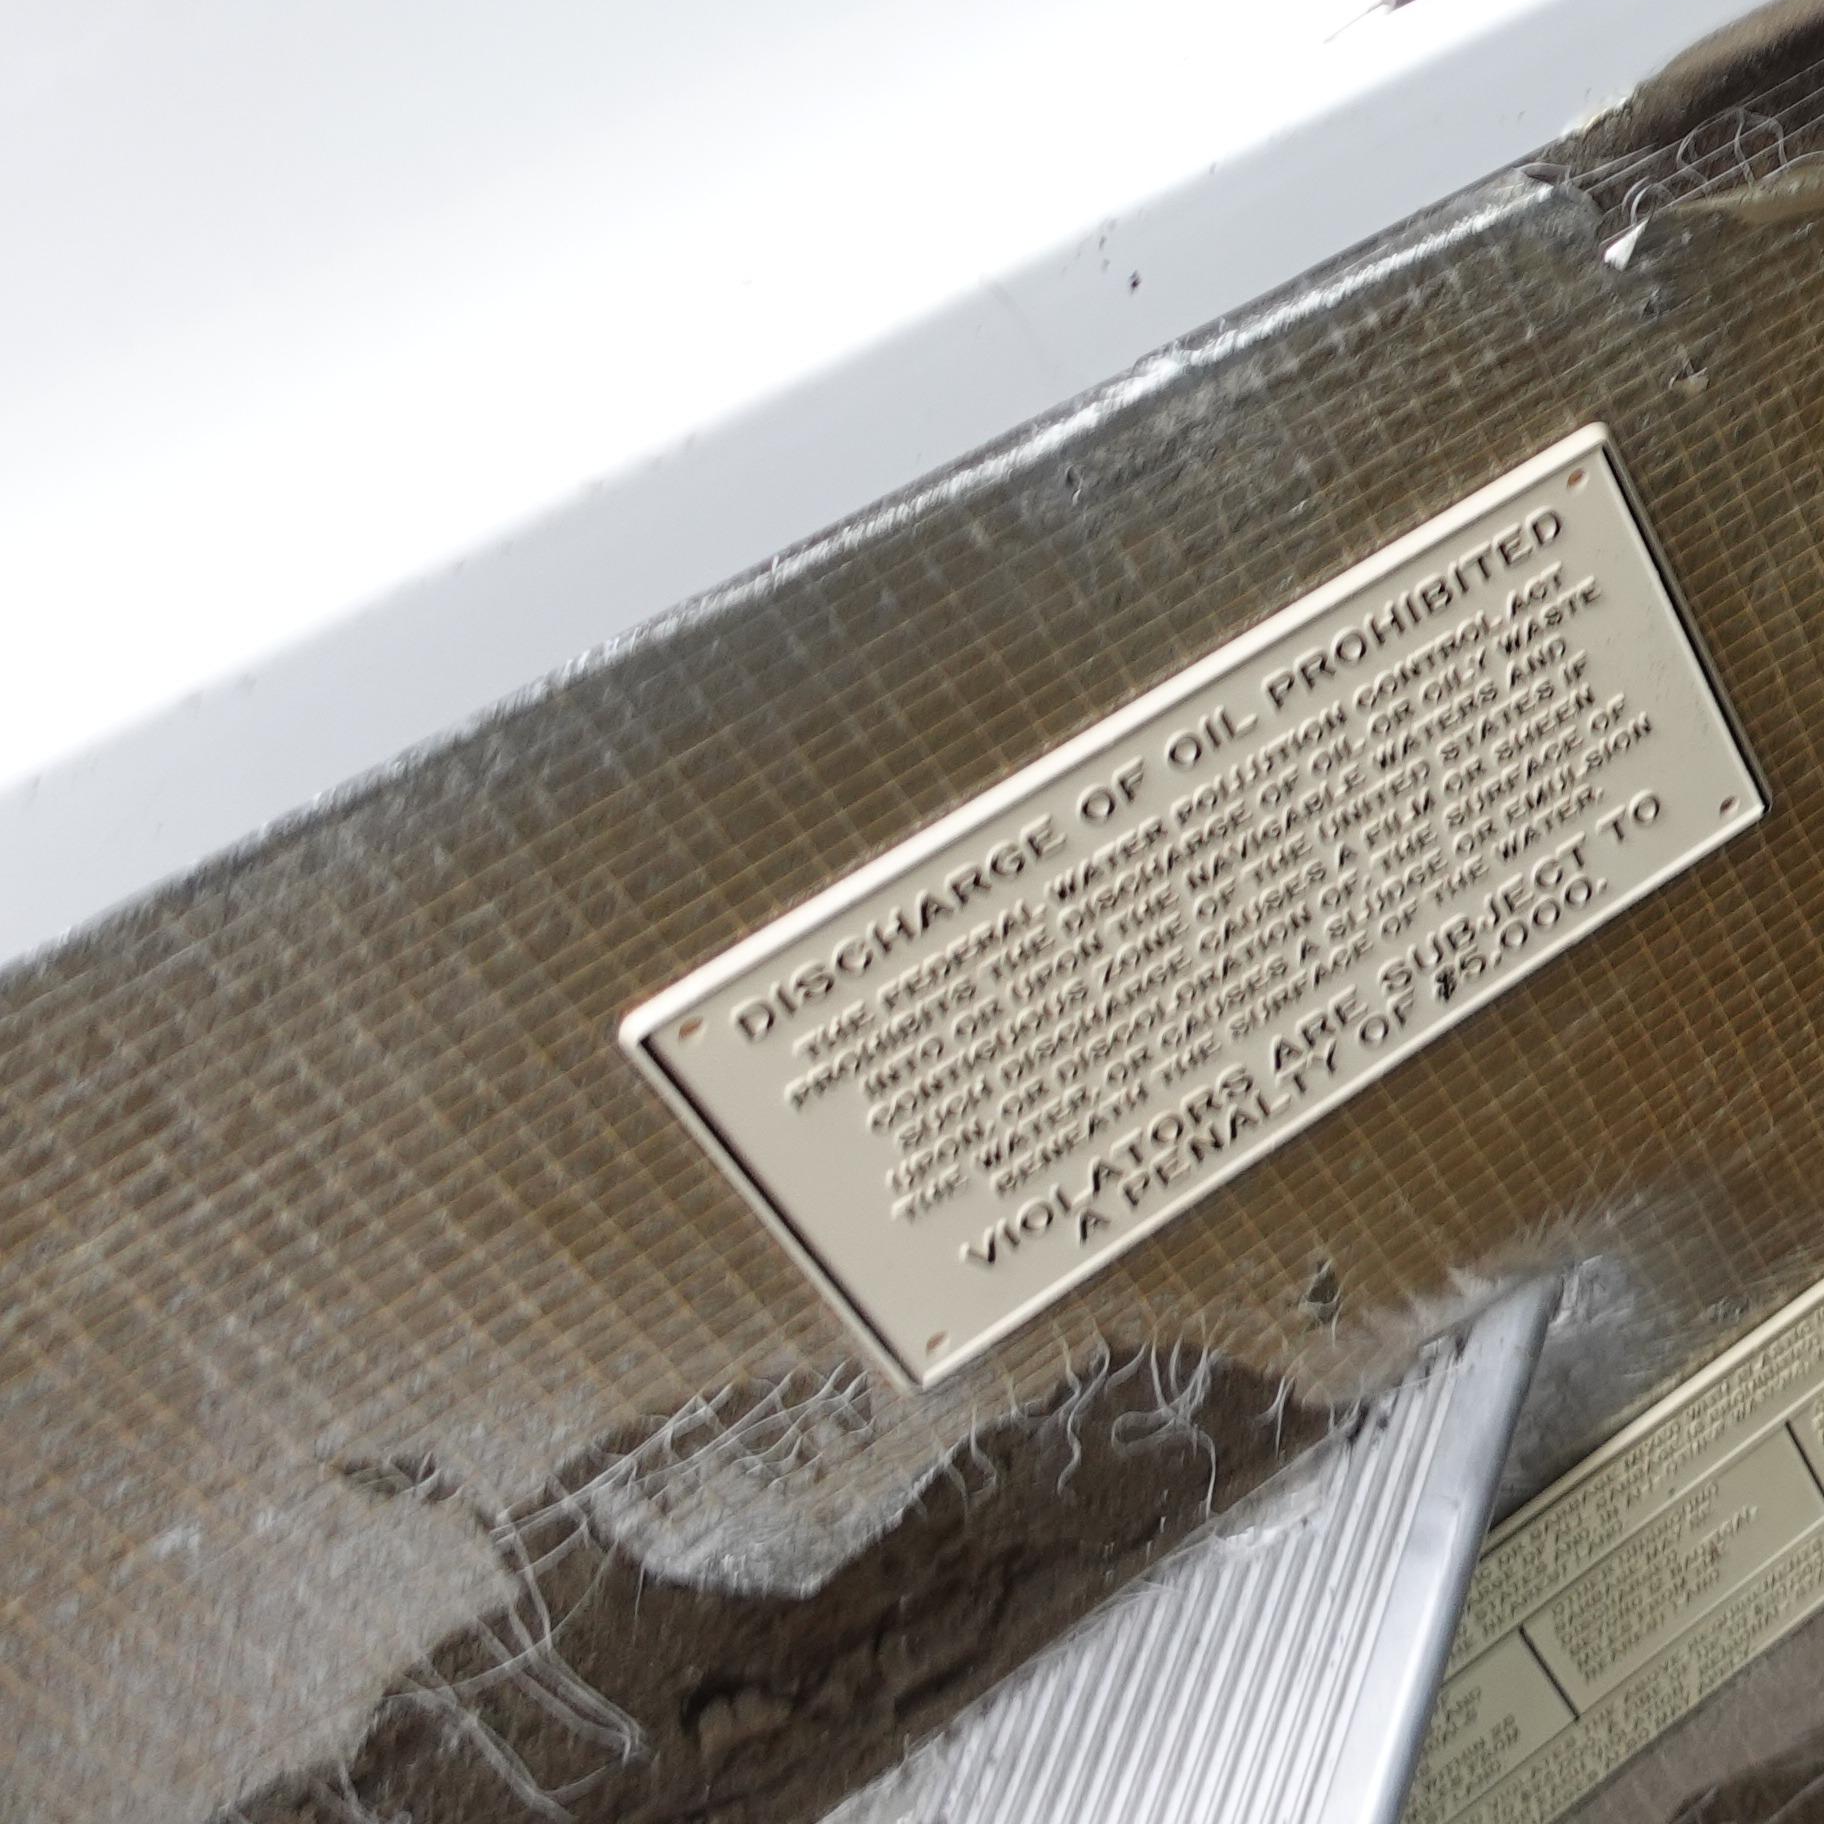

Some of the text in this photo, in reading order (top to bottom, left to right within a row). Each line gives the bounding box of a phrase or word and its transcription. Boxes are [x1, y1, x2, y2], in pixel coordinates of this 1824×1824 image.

[722, 498, 1567, 1045] DISCHARGE OF OIL PROHIBITED
[778, 575, 1603, 1111] PROHIBITS THE DISCHARGE OF OIL OR OILY WASTE
[786, 560, 1571, 1068] THE FEDERAL WATER POLLUTION CONTROL ACT
[851, 630, 1570, 1102] INTO OR UPON THE NAVIGABLE WATERS AND
[858, 649, 1595, 1136] CONTIGUOUS ZONE OF THE UNITED STATES IF
[884, 1161, 971, 1228] THE
[1097, 1040, 1155, 1089] OR
[1151, 950, 1292, 1054] CAUSES
[1288, 930, 1322, 965] A
[1320, 846, 1450, 944] SLUDGE
[1448, 813, 1499, 861] OR
[1499, 711, 1655, 827] EMULSION
[888, 682, 1597, 1153] SUCH DISCHARGE CAUSES A FILM OR SHEEN
[992, 1072, 1052, 1123] OR
[1048, 900, 1316, 1087] DISCOLORATION
[1368, 819, 1440, 879] THE
[1440, 723, 1586, 833] SURFACE
[1583, 693, 1633, 740] OF
[953, 785, 1666, 1276] VIOLATORS ARE SUBJECT TO
[983, 1077, 1152, 1198] BENEATH
[1146, 1029, 1224, 1092] THE
[1221, 927, 1377, 1043] SURFACE
[1372, 896, 1425, 943] OF
[1421, 852, 1491, 911] THE
[1061, 1197, 1113, 1247] A
[1112, 1037, 1351, 1212] PENALTY
[1350, 984, 1428, 1054] OF
